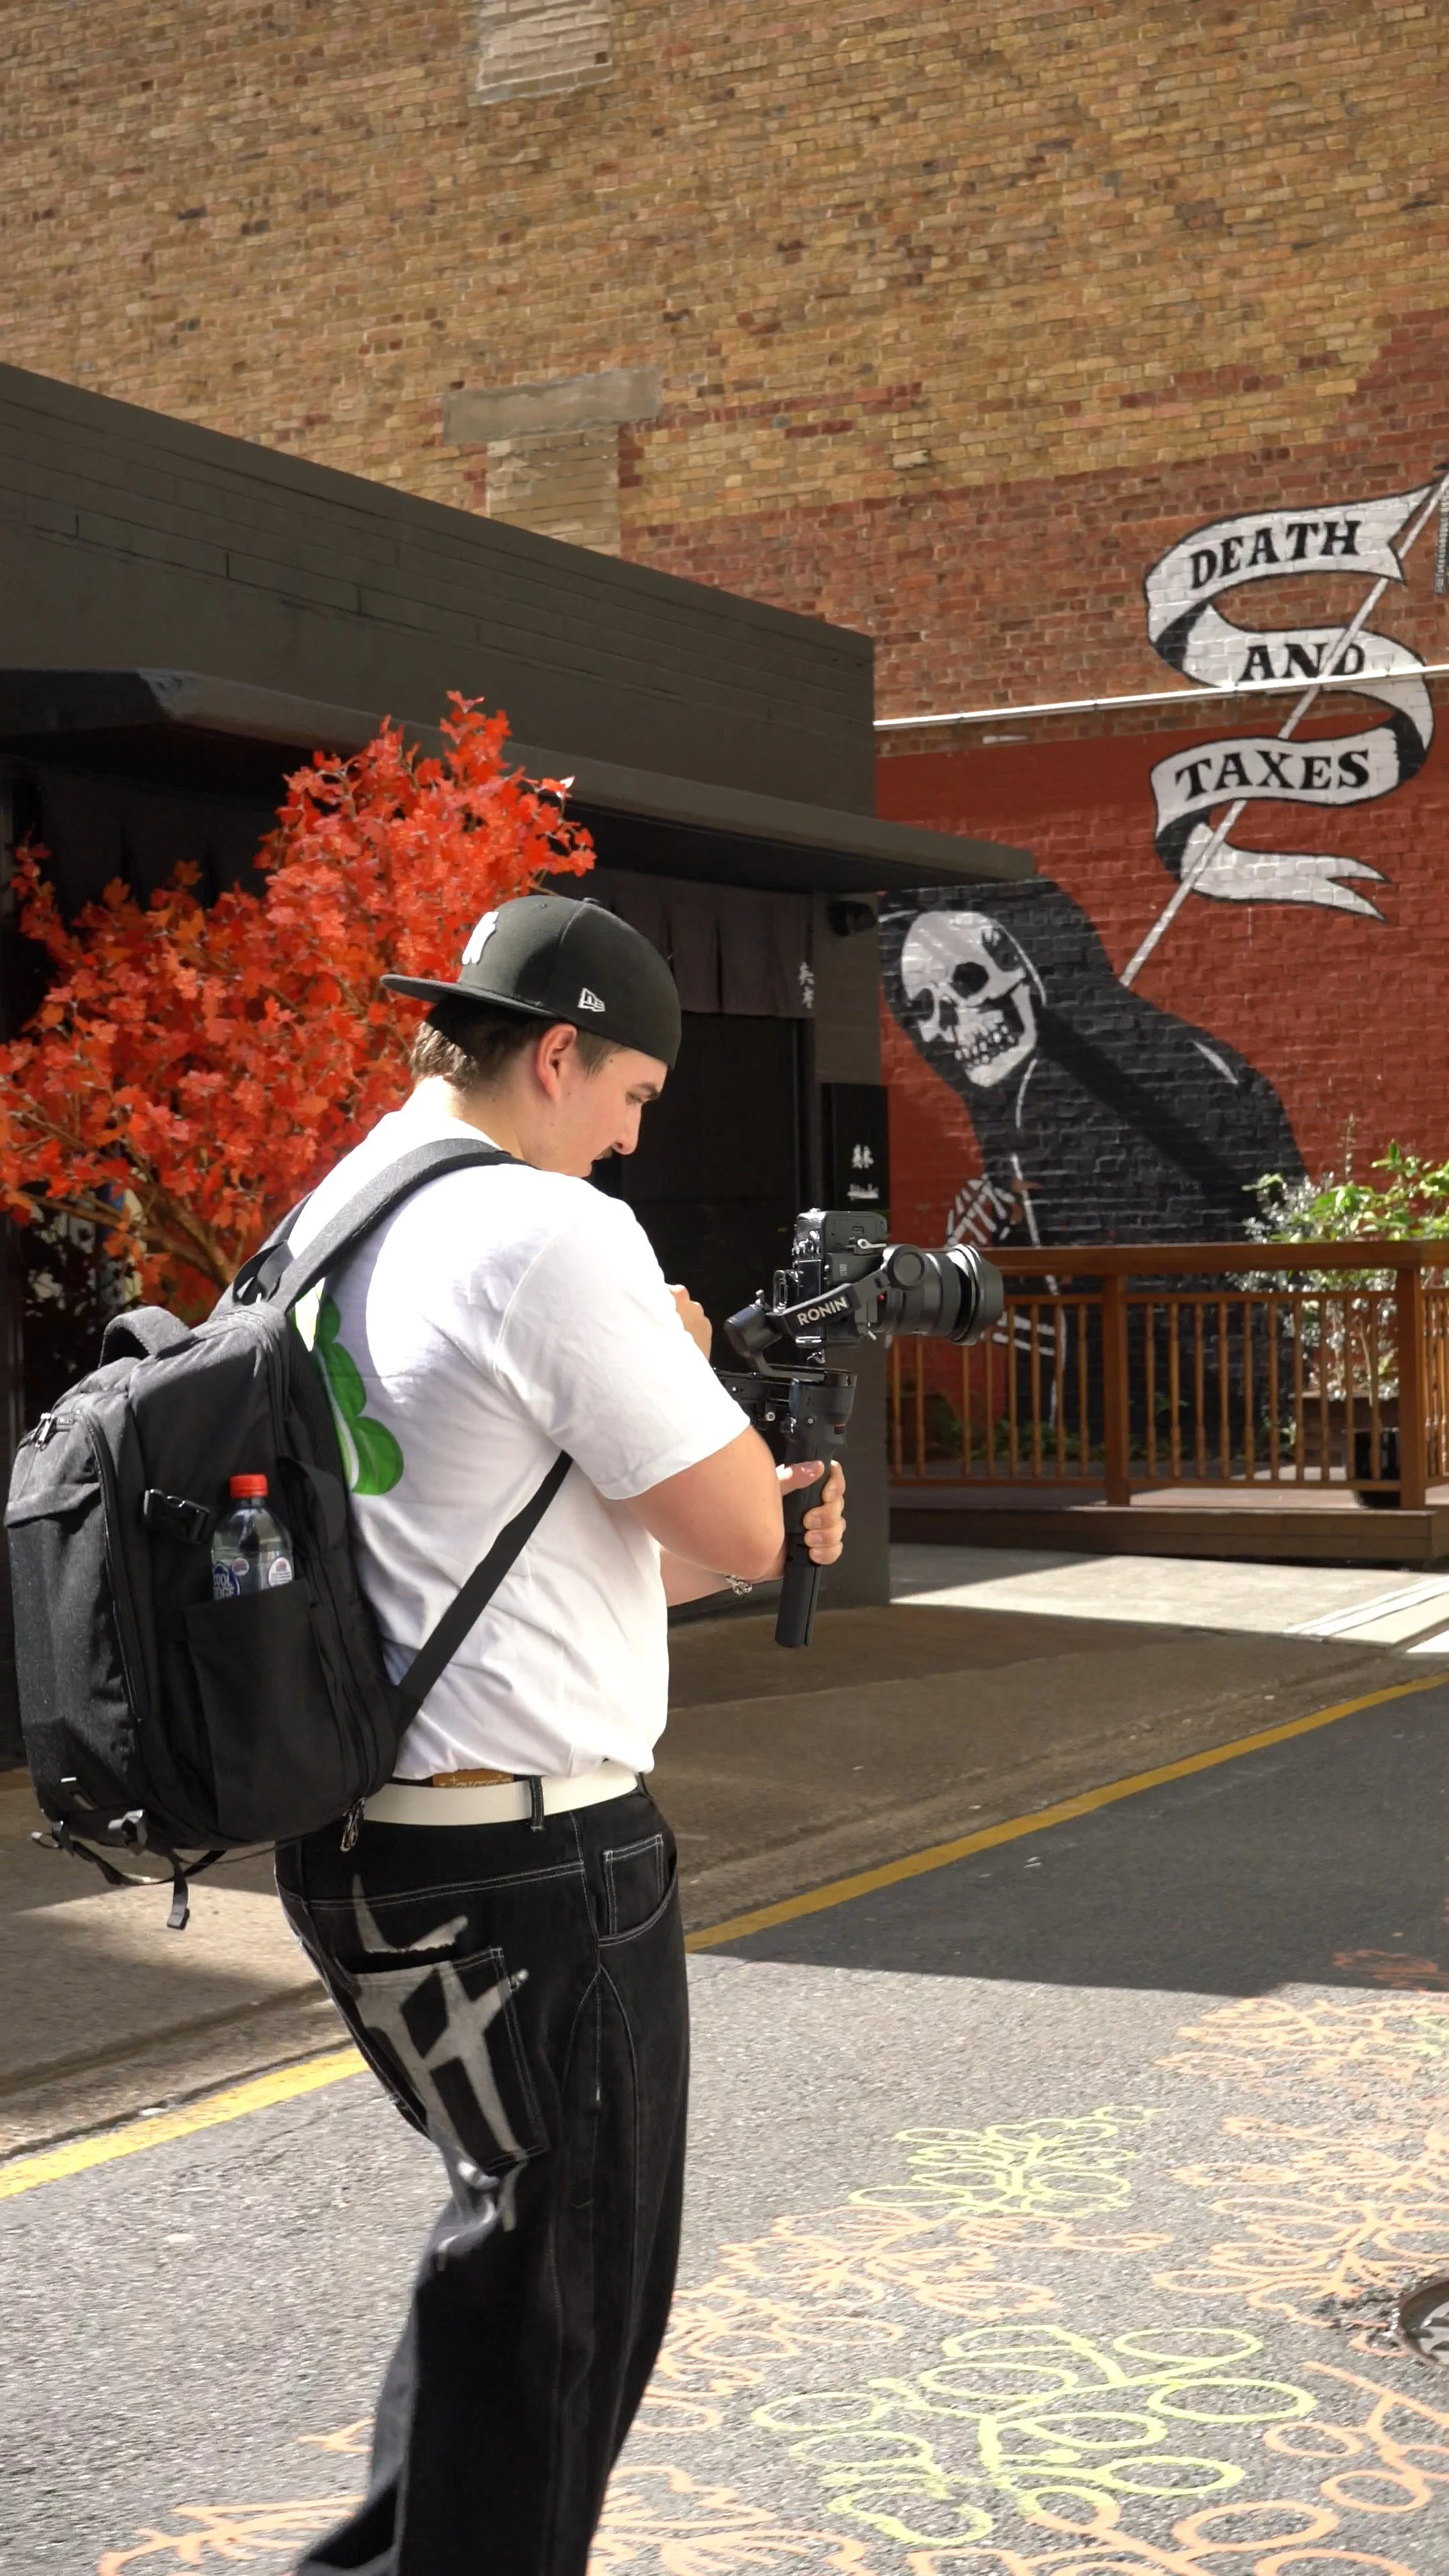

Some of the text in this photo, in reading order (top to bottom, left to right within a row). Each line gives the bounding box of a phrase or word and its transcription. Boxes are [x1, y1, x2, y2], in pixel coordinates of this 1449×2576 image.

[1189, 520, 1364, 590] DEATH
[1237, 643, 1365, 682] AND
[1175, 749, 1370, 800] TAXES
[796, 1295, 849, 1326] RONIN
